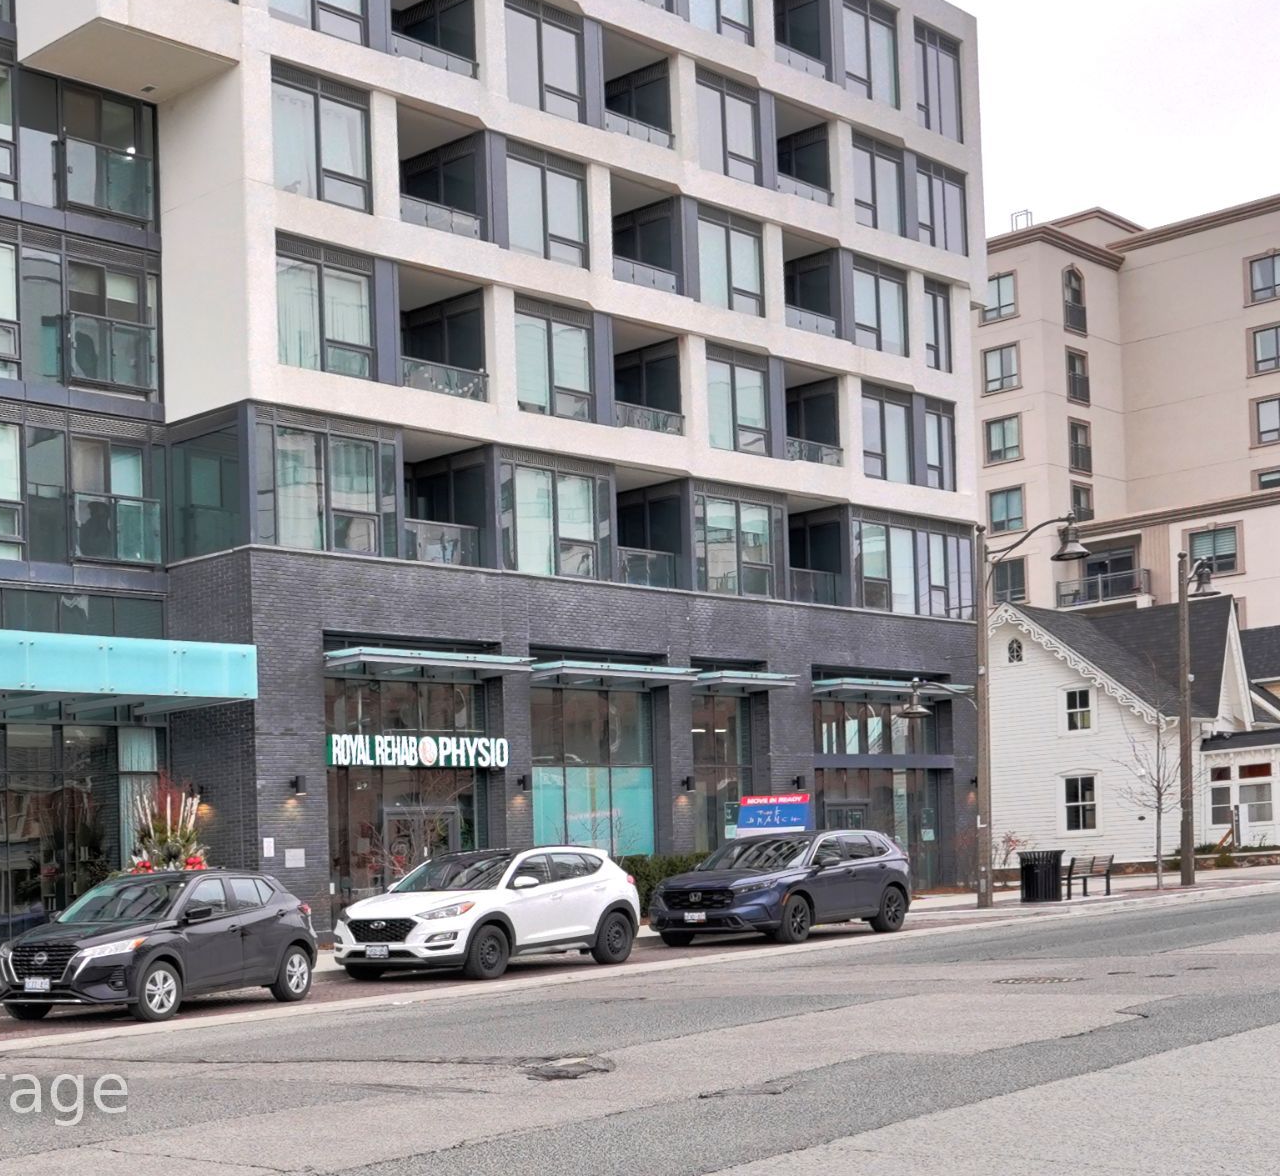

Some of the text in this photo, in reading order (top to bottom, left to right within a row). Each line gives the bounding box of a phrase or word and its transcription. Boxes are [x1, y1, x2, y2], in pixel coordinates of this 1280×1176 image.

[332, 734, 509, 767] ROYAL REHAB PHYSIO
